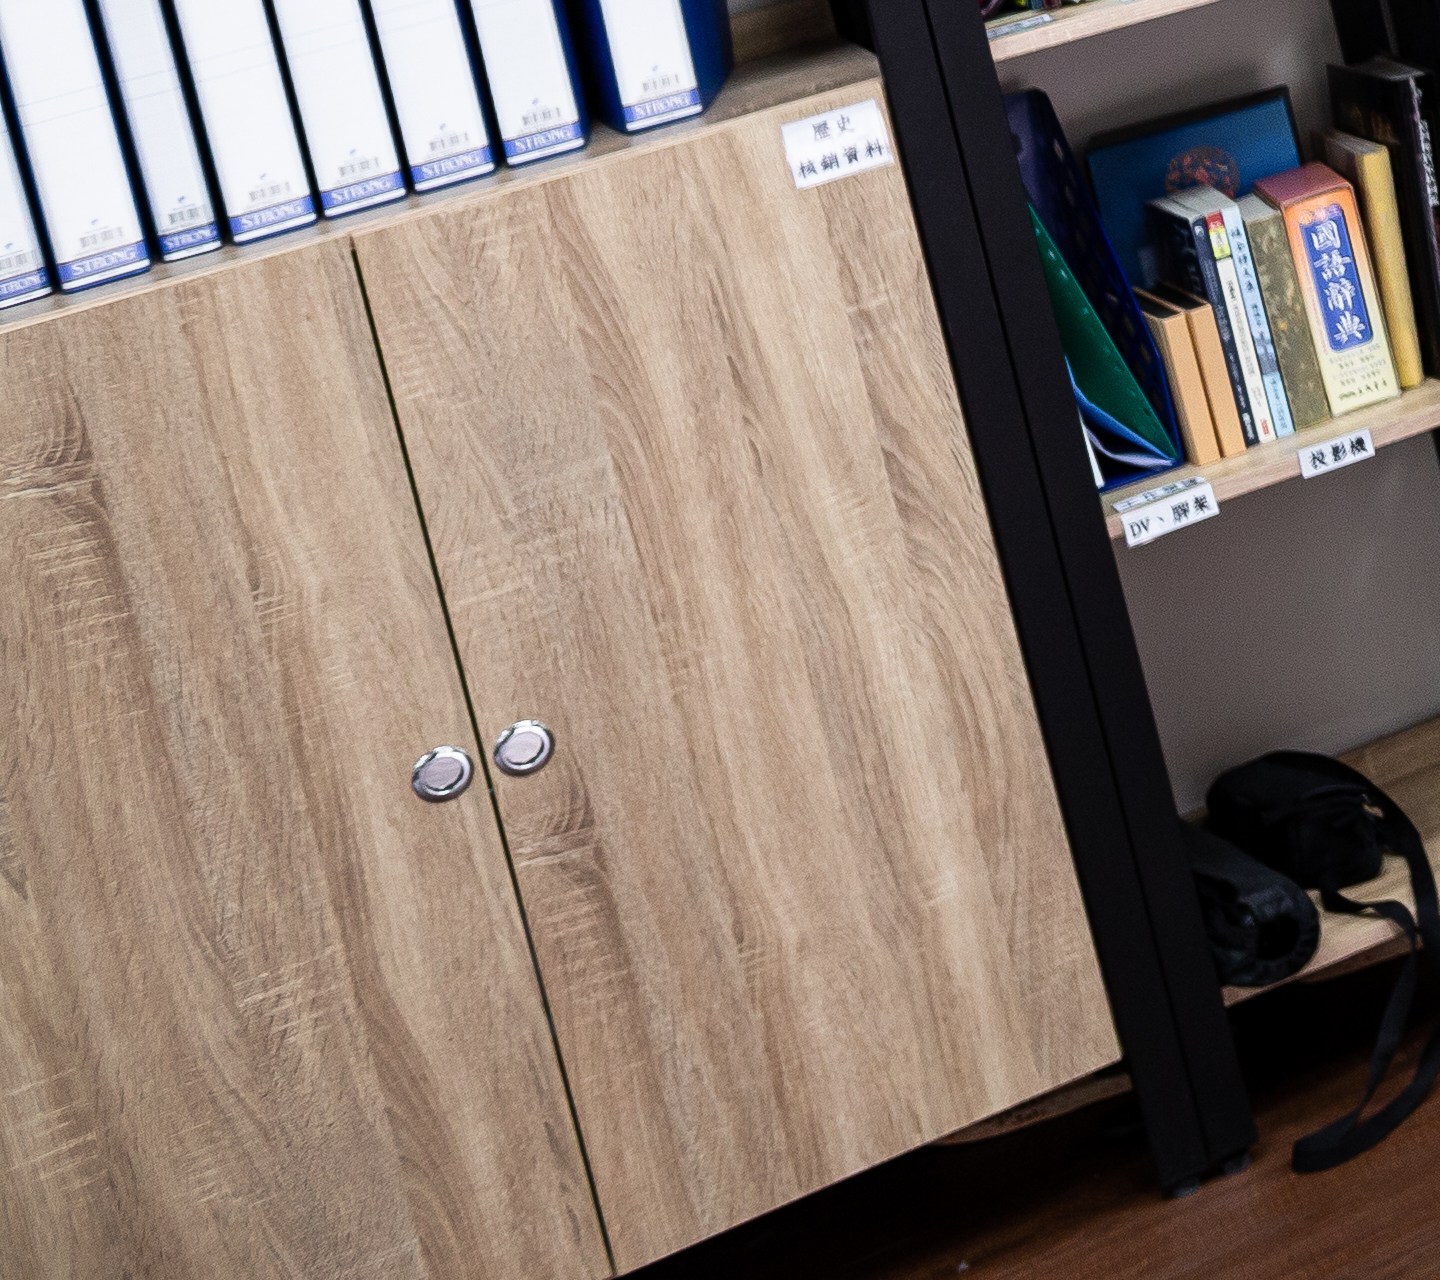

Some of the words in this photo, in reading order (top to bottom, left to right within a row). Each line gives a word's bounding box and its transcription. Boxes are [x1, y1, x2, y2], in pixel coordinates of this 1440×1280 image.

[633, 91, 694, 121] STRONG
[511, 126, 577, 155] STRONG
[420, 150, 488, 180] STRONG
[798, 138, 884, 179] 核銷資料
[329, 175, 396, 208] STRONG
[239, 201, 307, 232] STRONG
[70, 247, 138, 276] STRONG
[1311, 219, 1367, 344] 國語辭典
